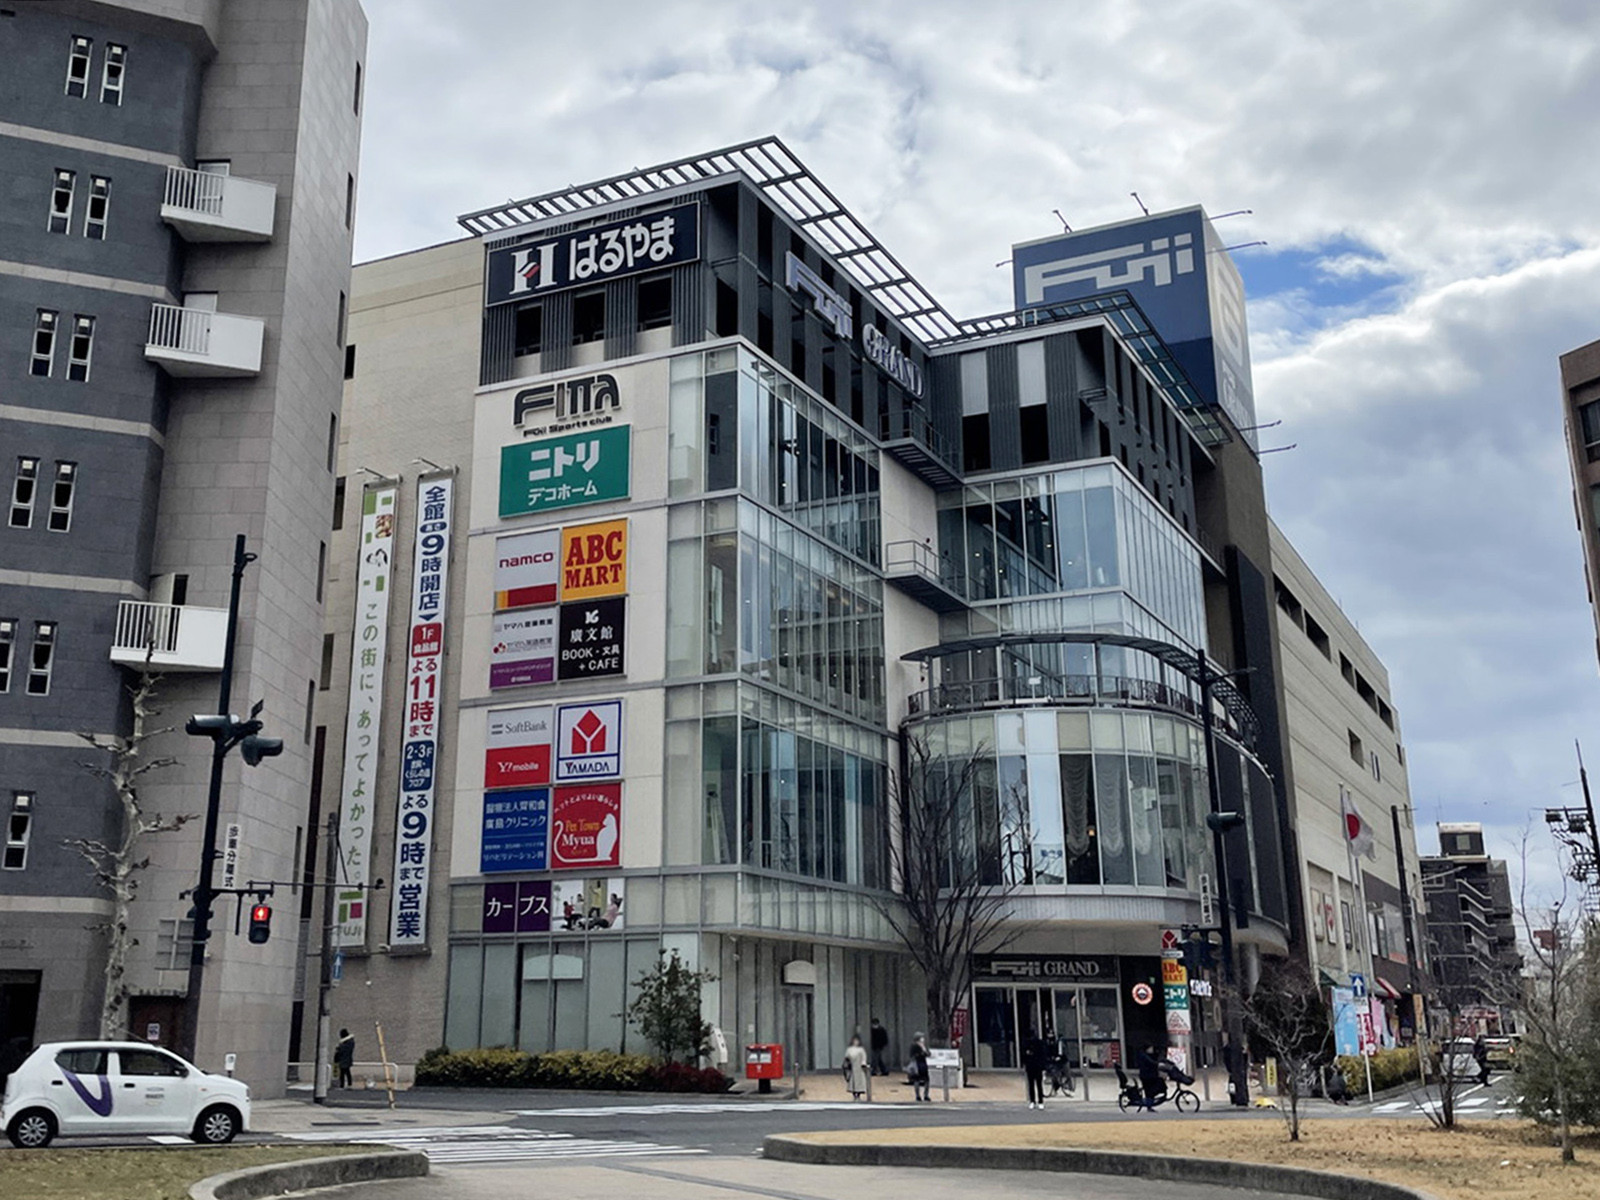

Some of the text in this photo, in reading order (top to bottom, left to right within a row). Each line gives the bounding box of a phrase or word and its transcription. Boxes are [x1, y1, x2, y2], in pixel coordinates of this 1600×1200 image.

[569, 215, 675, 281] はるやま
[863, 322, 924, 399] GRAND
[529, 440, 600, 481] ニトリ
[528, 480, 598, 506] デコホーム
[499, 551, 554, 568] namco
[565, 531, 623, 567] ABC
[564, 563, 623, 589] MART
[588, 657, 619, 671] CAFE
[505, 720, 547, 734] SoftBank
[565, 762, 610, 775] YAMADA
[1043, 961, 1100, 975] GRAND
